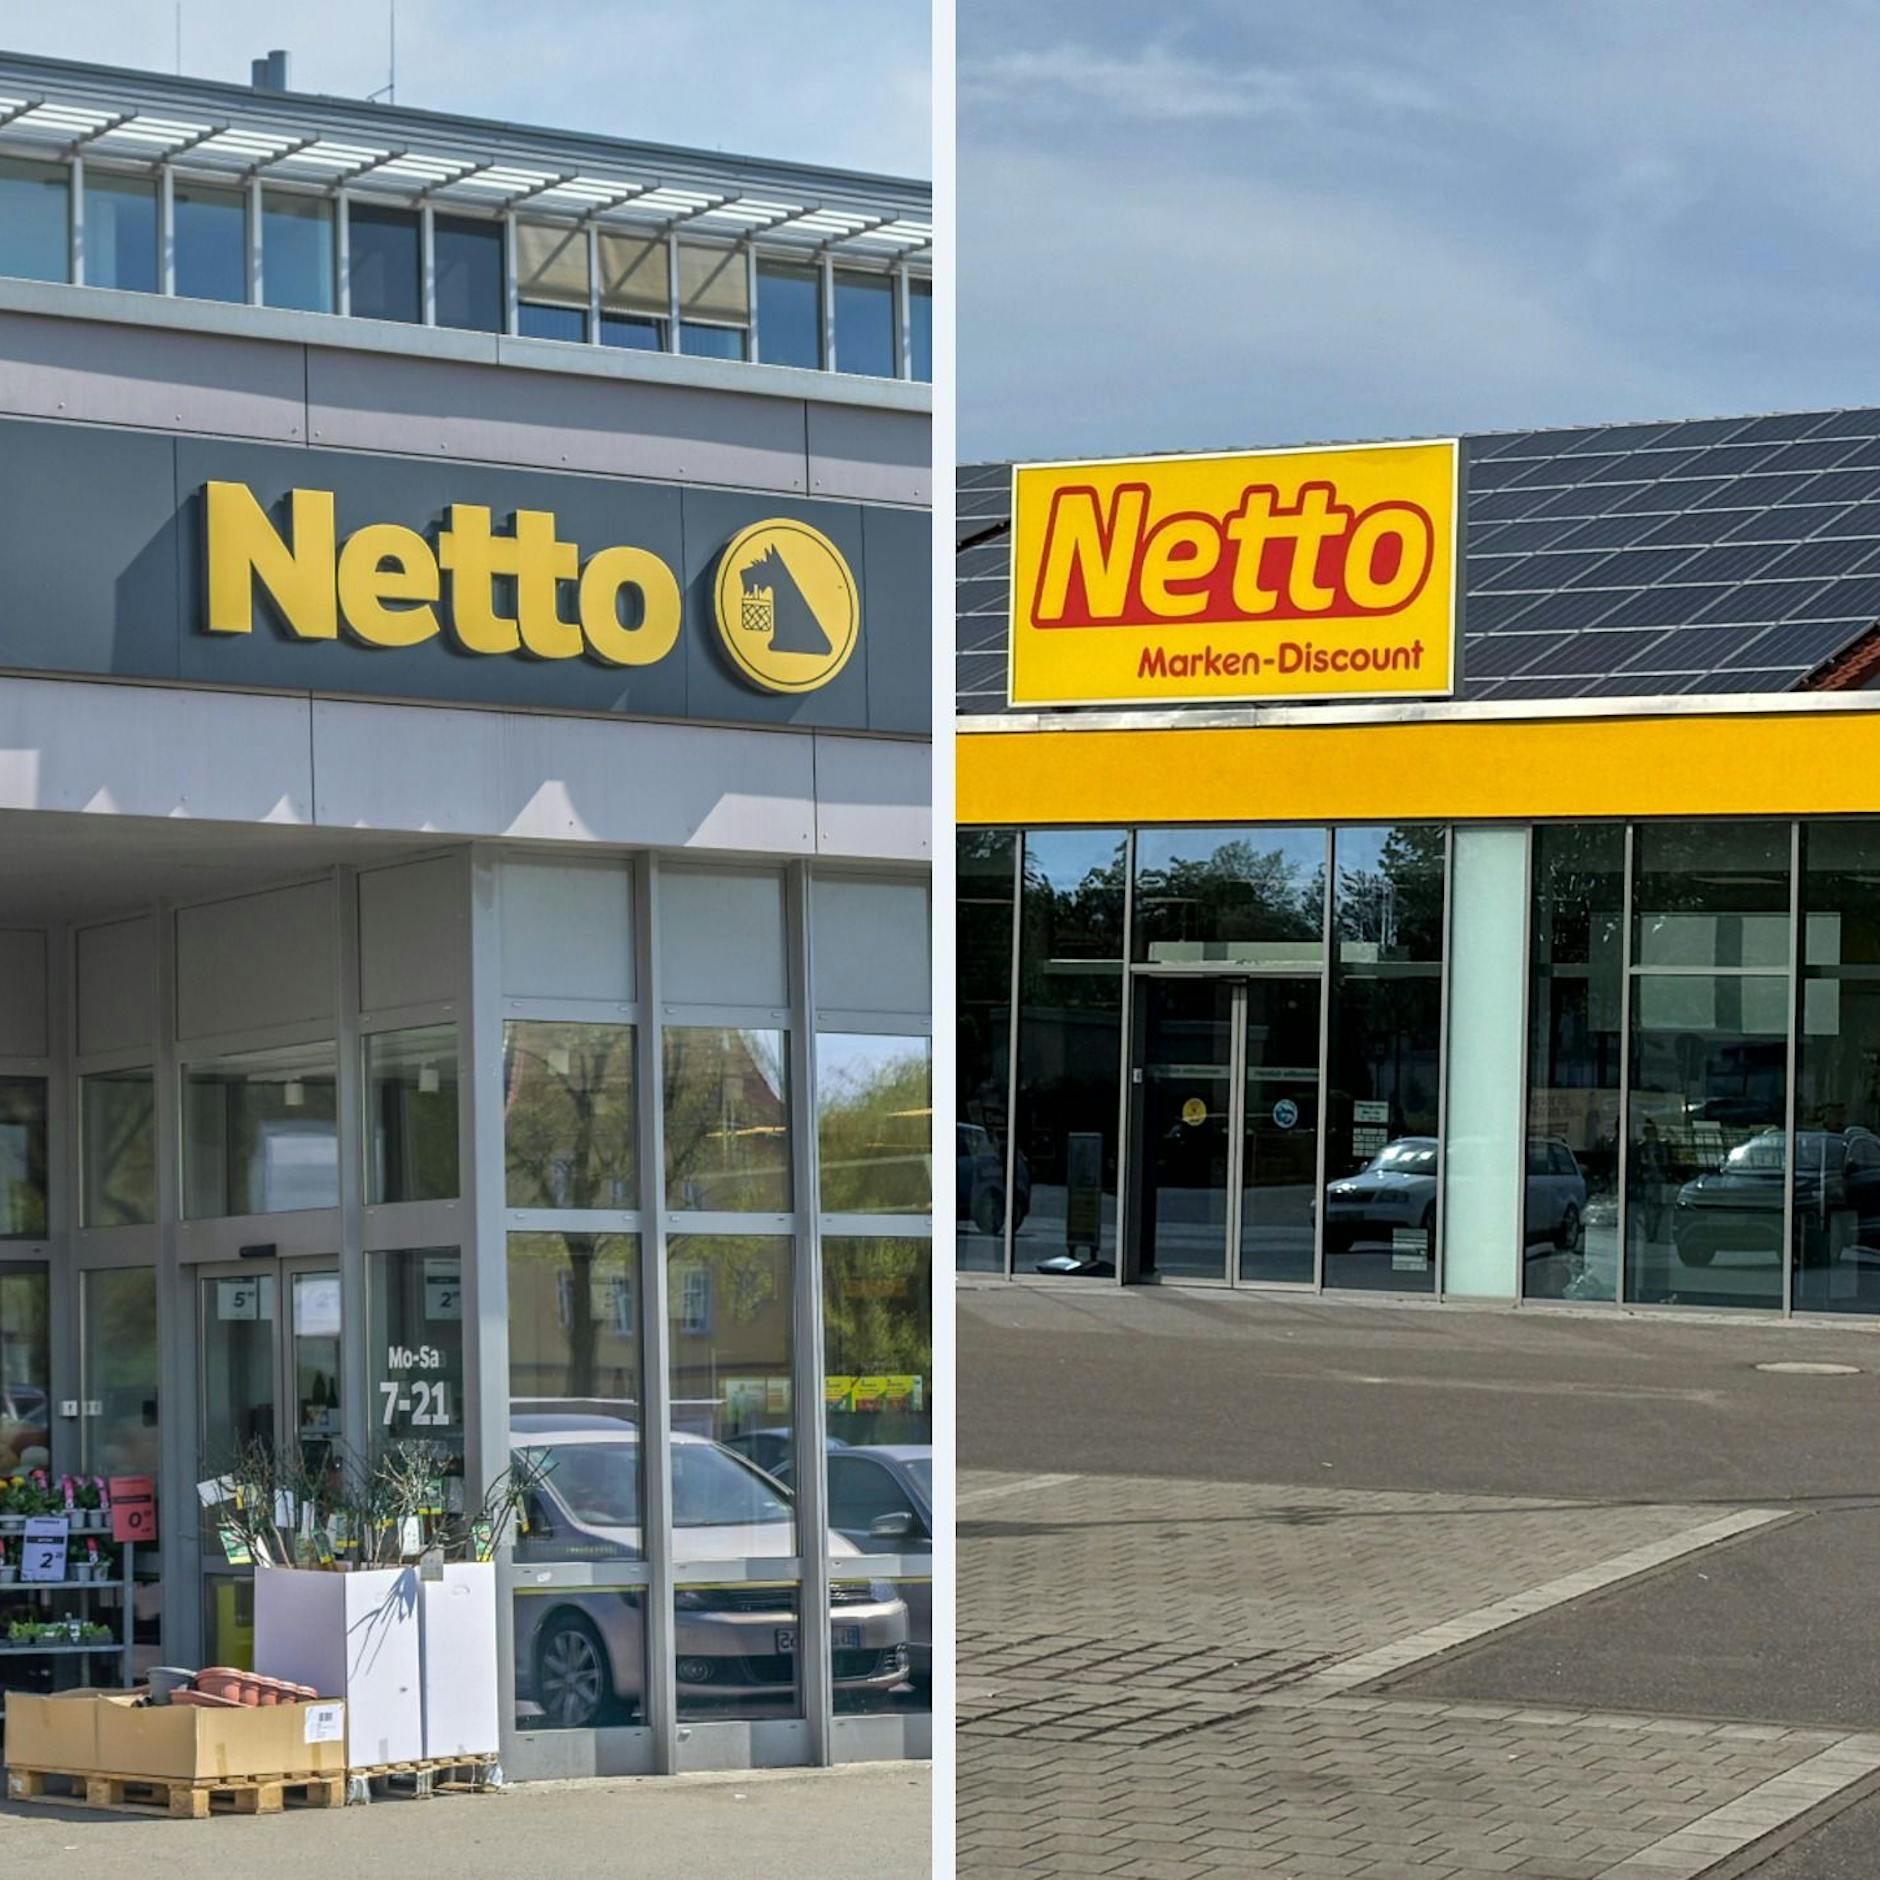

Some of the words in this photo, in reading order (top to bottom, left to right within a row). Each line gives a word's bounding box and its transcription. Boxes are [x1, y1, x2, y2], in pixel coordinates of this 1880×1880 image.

[205, 481, 682, 667] Netto
[1031, 480, 1435, 629] Netto
[1137, 638, 1424, 680] Marken-Discount
[388, 1344, 440, 1369] Mo-Sa
[379, 1380, 450, 1426] 7-21
